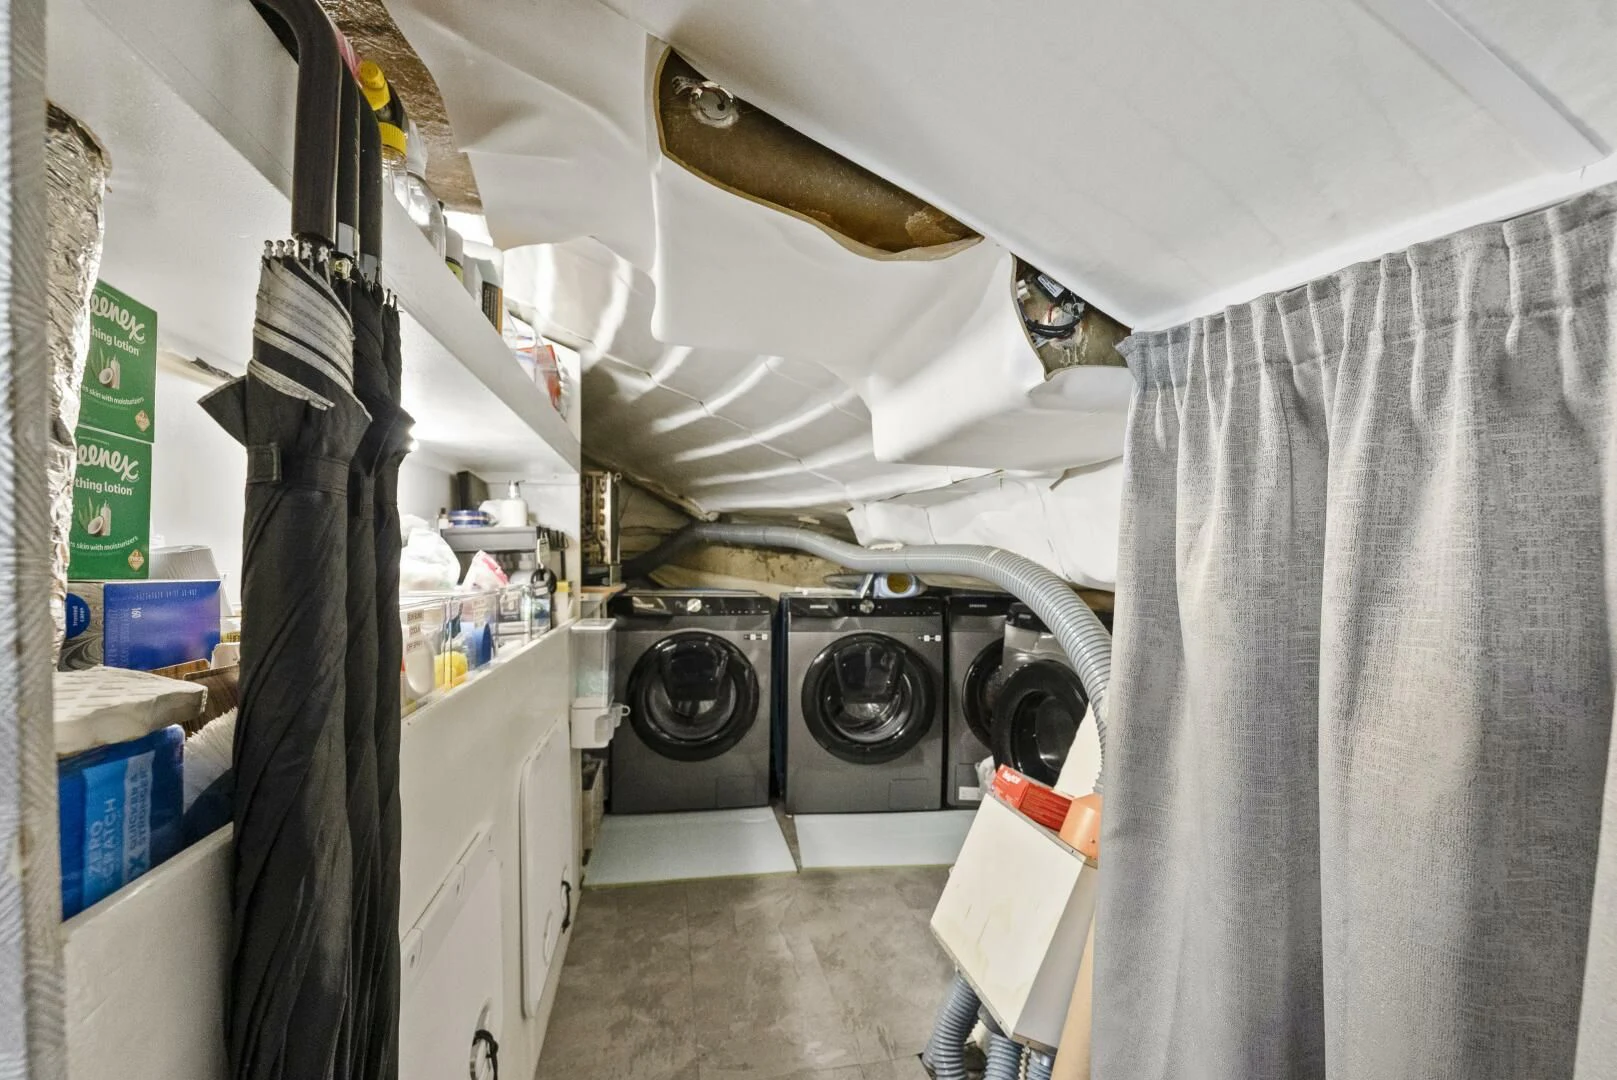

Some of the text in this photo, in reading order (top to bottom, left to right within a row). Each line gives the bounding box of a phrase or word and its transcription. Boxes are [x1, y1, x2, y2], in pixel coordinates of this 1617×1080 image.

[114, 335, 139, 357] lotion
[101, 393, 114, 403] with
[104, 480, 132, 496] lotion
[76, 541, 90, 550] skin
[90, 543, 104, 551] with
[103, 536, 139, 551] moisturizers
[88, 821, 104, 877] ZERO
